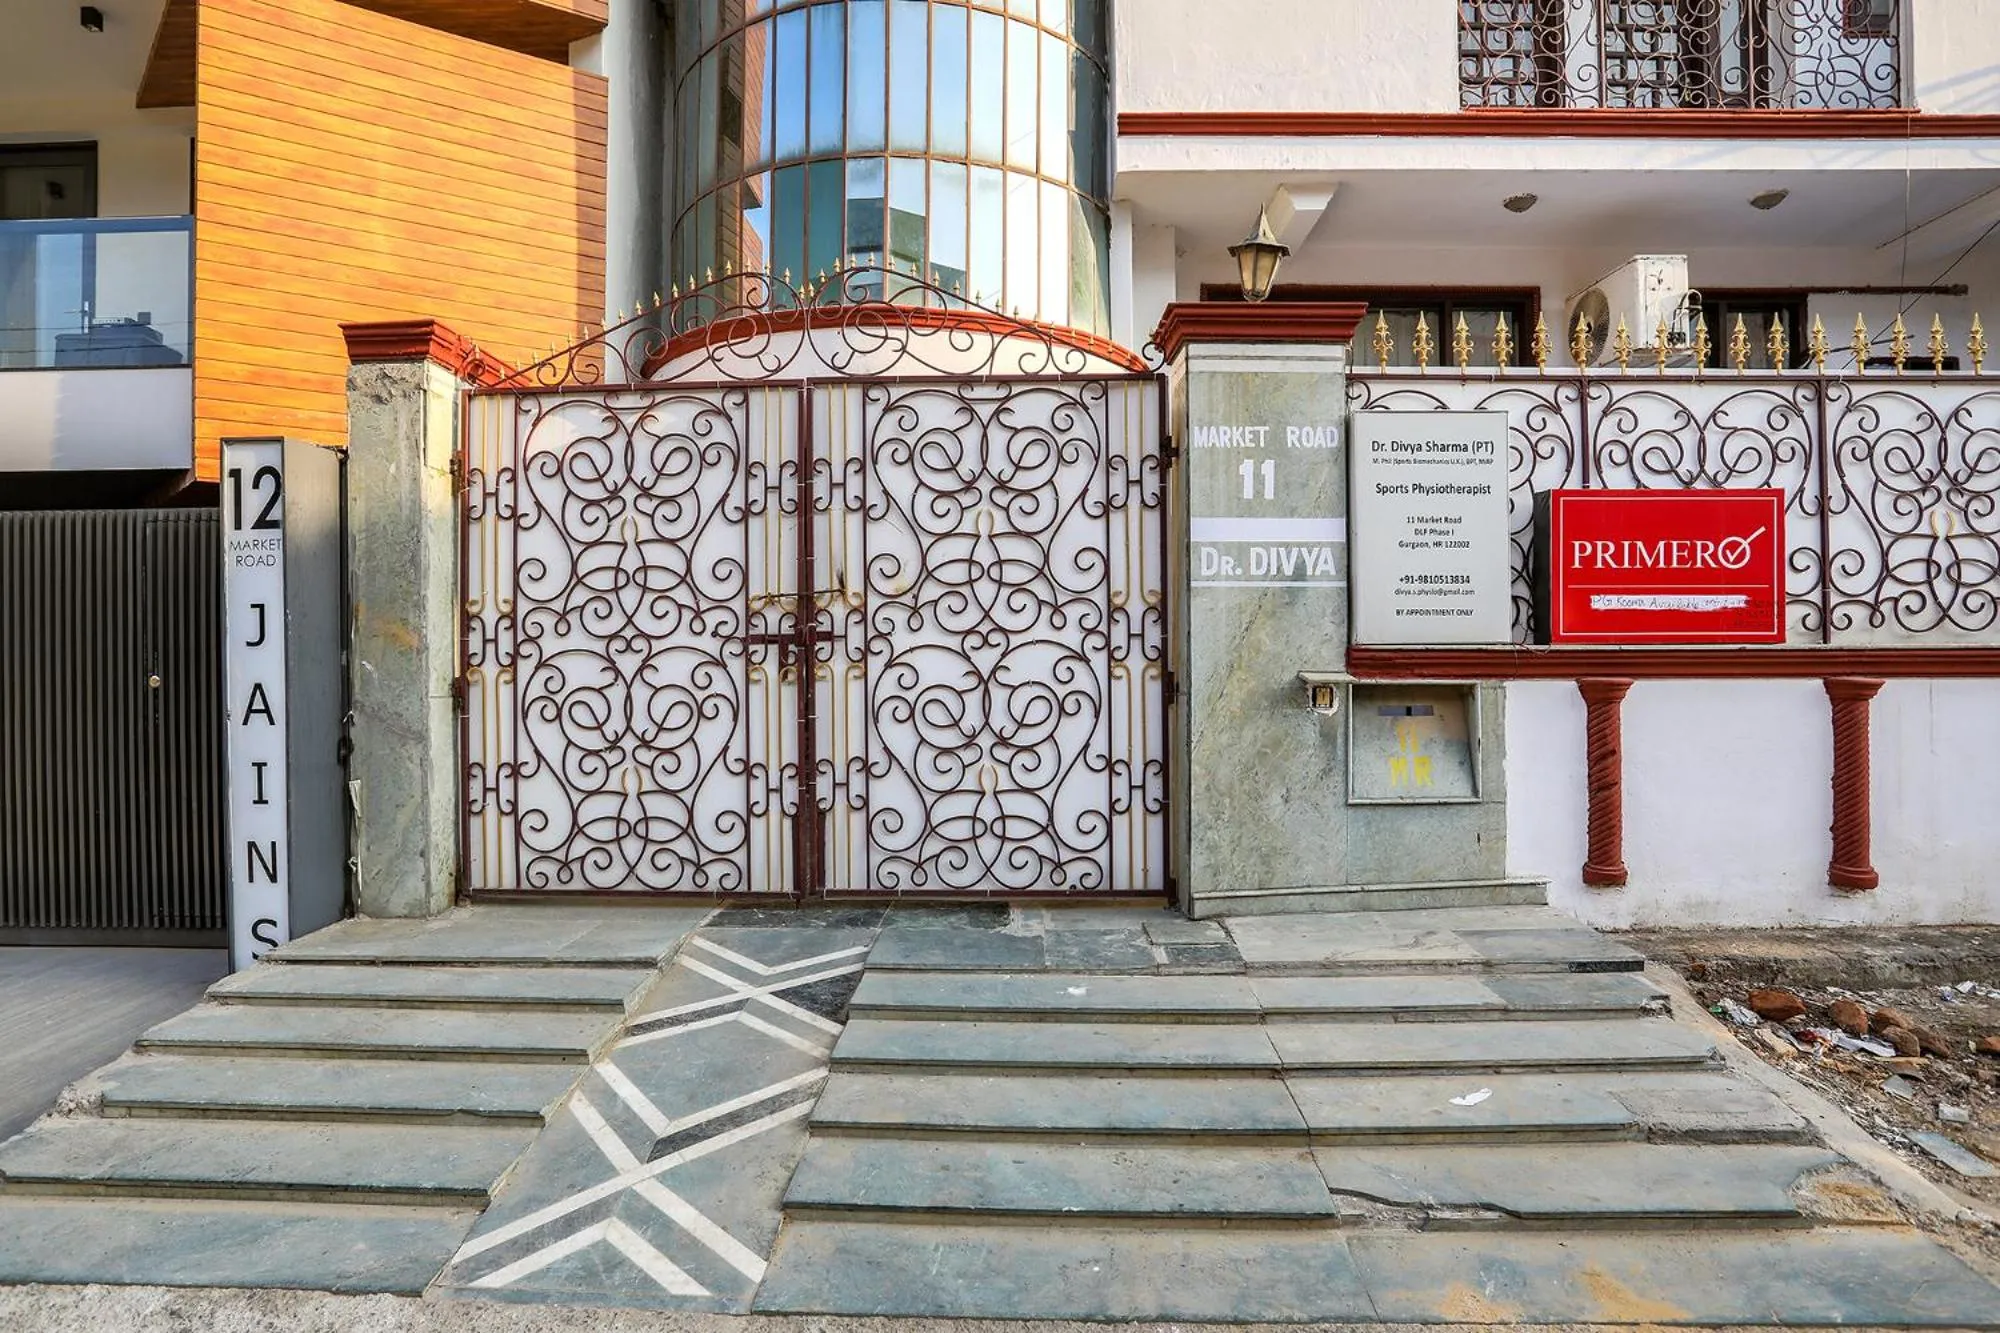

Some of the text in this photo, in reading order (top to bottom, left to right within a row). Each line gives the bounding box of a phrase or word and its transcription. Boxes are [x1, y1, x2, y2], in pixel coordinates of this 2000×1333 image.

[1193, 426, 1339, 448] MARKET ROAD
[1371, 440, 1495, 455] Dr. Divya Sharma (PT)
[1238, 459, 1275, 500] 11
[1375, 483, 1491, 496] Sports Physiotherapist
[228, 464, 282, 531] 12
[1406, 516, 1462, 524] 11 Market Road
[1414, 528, 1427, 536] DLF
[1429, 528, 1450, 536] Phase
[229, 538, 282, 551] MARKET
[1398, 540, 1470, 550] Gurgaon, HR 122002
[1571, 535, 1753, 569] PRIMERO
[235, 554, 277, 568] ROAD
[1250, 546, 1337, 577] DIVYA
[1399, 574, 1471, 585] +91-9810513834
[1395, 609, 1474, 617] BY APPOINTMENT ONLY
